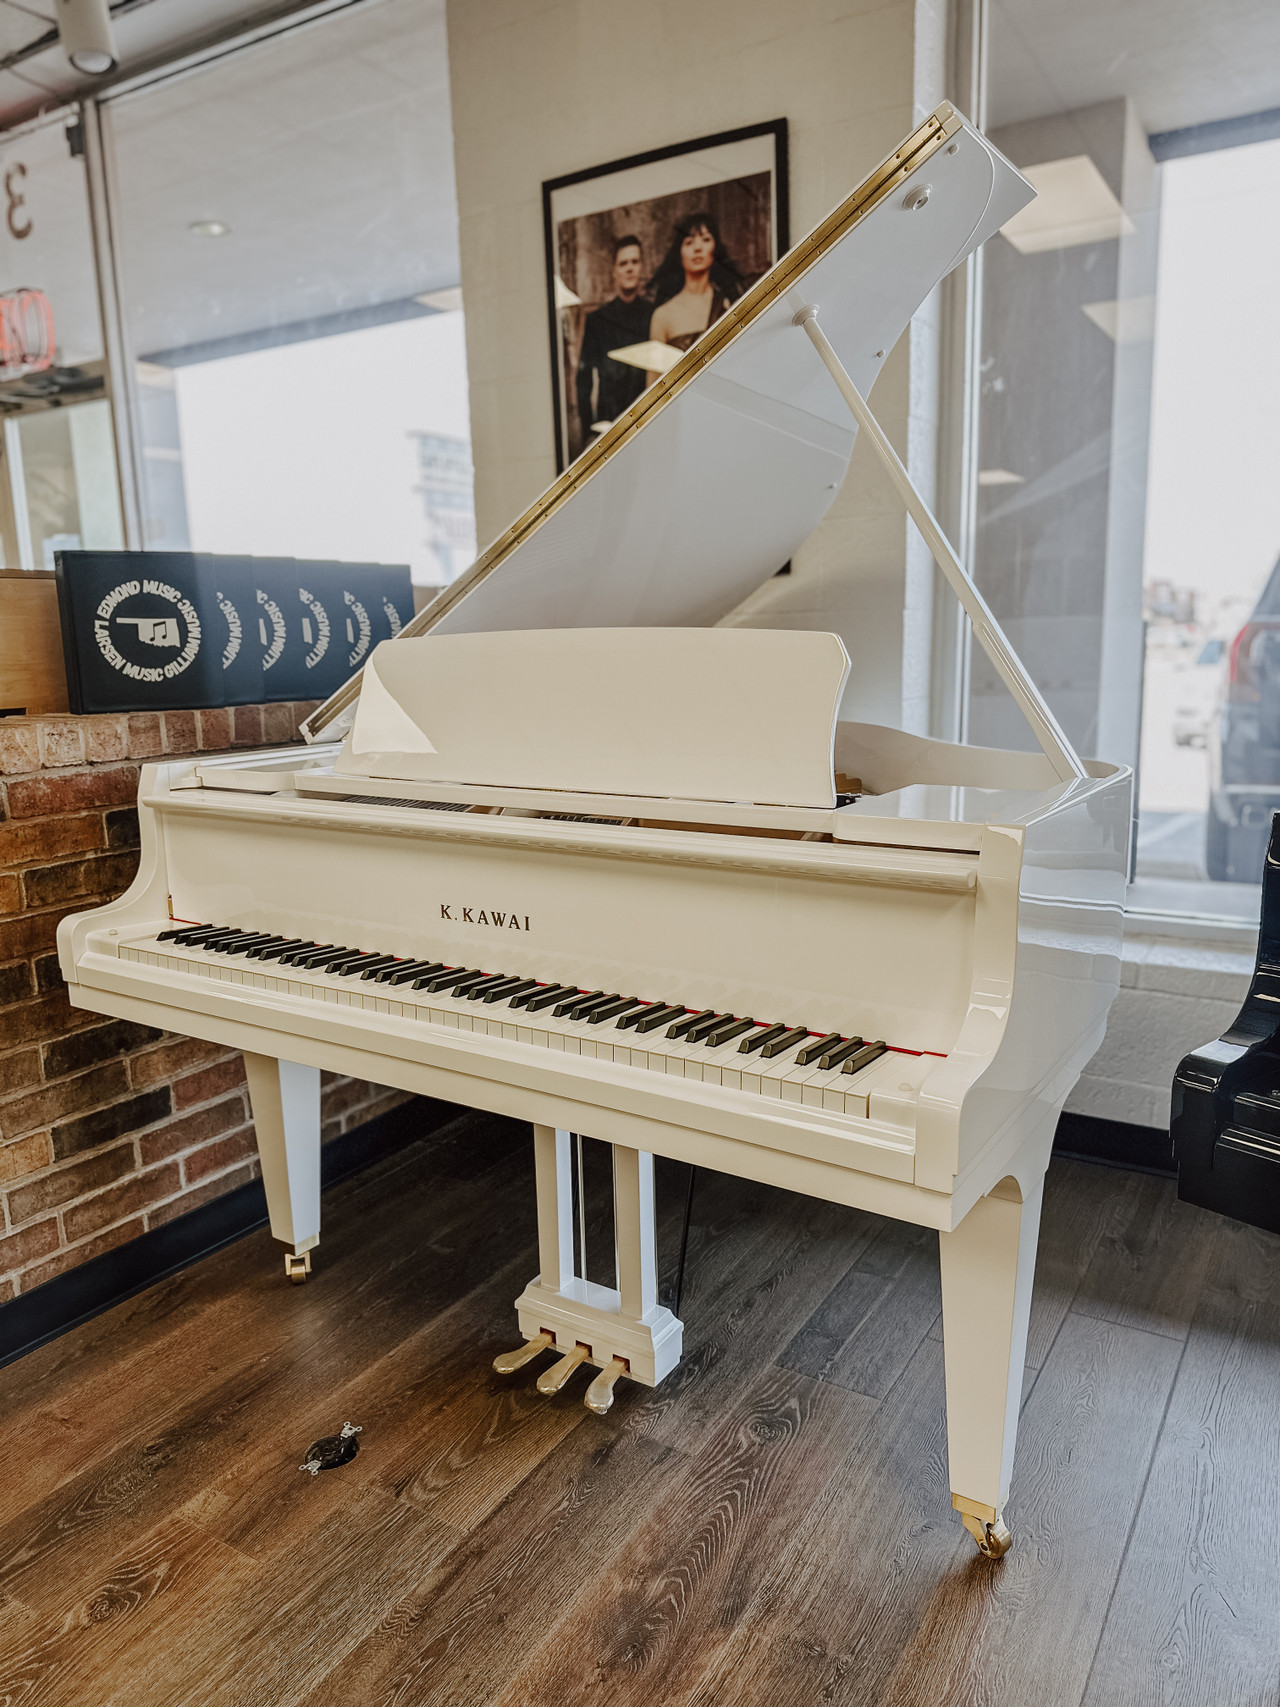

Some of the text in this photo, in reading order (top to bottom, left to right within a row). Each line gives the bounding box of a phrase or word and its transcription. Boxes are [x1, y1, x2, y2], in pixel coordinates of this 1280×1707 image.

[97, 579, 181, 619] EDMOND MUSIC
[219, 600, 242, 638] MUSIC
[264, 601, 286, 638] MUSIC
[309, 601, 331, 636] MUSIC
[351, 602, 371, 636] MUSIC
[94, 599, 202, 682] LARSEN MUSIC GILLIAM MUSIC
[440, 904, 530, 931] K.KAWAI
